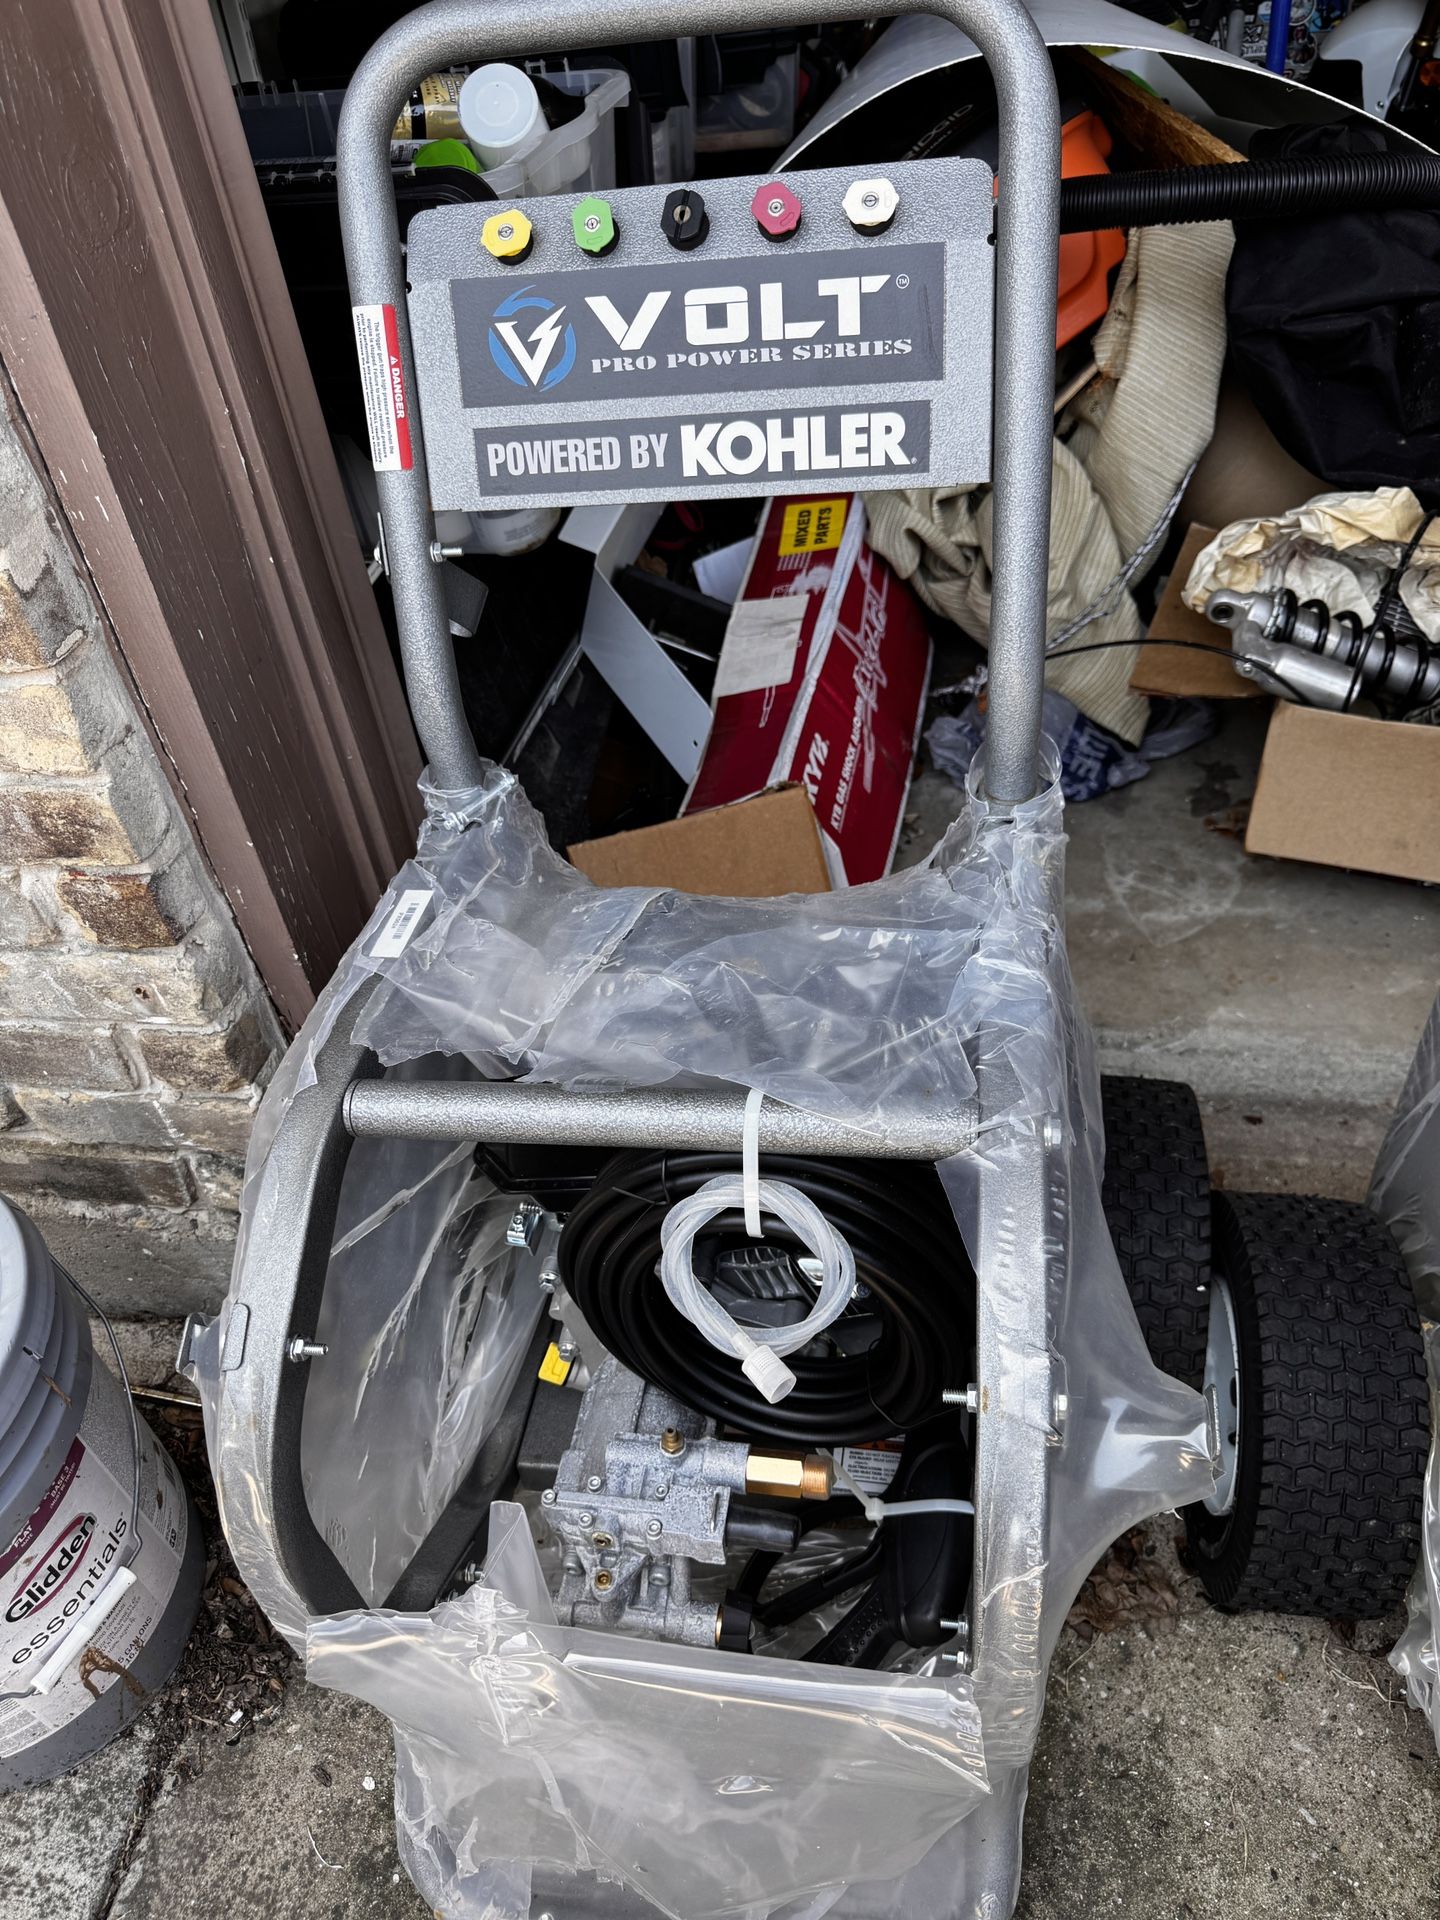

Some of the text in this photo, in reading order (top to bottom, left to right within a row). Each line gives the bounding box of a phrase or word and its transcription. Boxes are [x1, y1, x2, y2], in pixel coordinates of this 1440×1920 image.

[374, 332, 382, 351] trigger
[585, 274, 891, 351] VOLT
[591, 338, 913, 374] PRO POWER SERIES
[391, 367, 405, 418] DANGER
[486, 411, 911, 478] POWERED BY KOHLER
[793, 510, 811, 548] MIXED
[814, 507, 832, 545] PARTS
[803, 732, 829, 805] KYB
[830, 742, 856, 832] KYB GAS SHOCK
[14, 1524, 32, 1548] FLAT
[5, 1515, 96, 1623] Glidden
[12, 1518, 127, 1664] essentials
